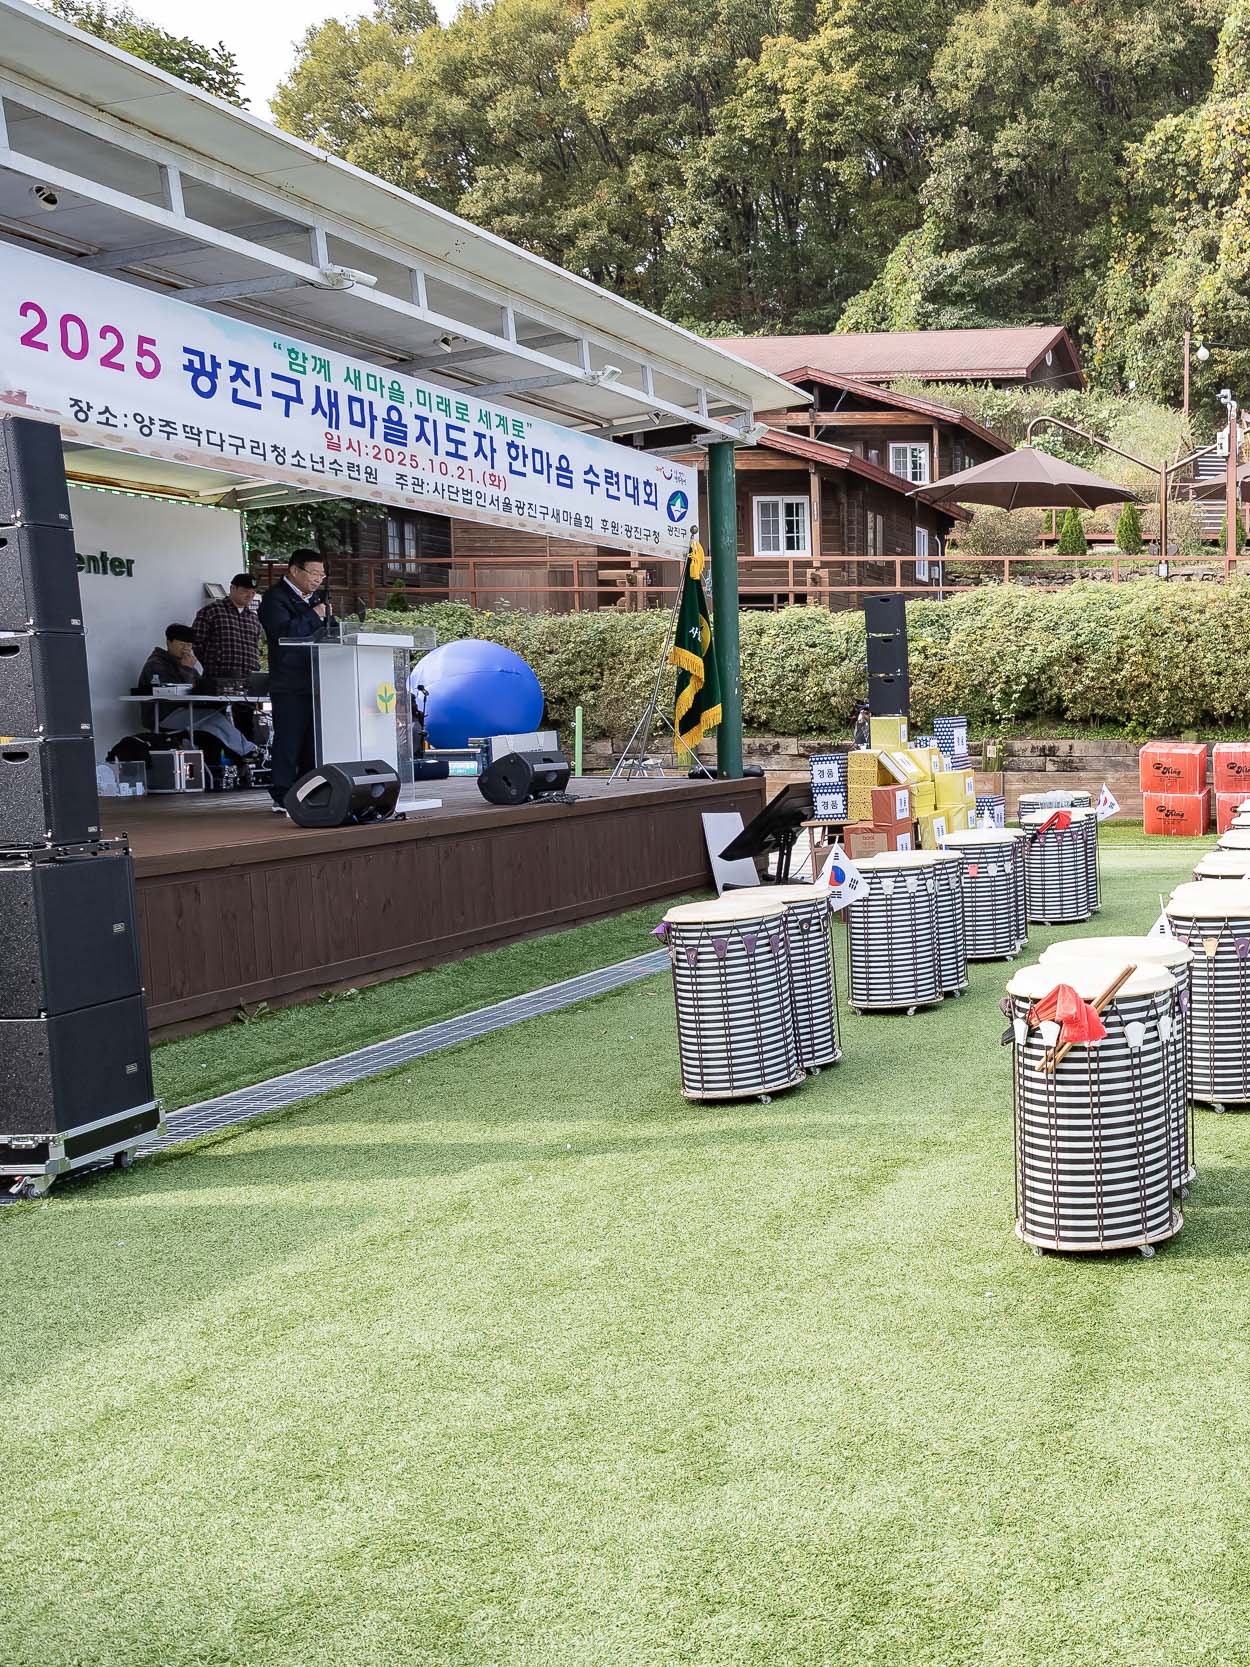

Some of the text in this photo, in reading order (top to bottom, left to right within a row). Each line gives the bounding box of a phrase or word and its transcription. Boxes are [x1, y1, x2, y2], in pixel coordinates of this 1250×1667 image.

[20, 301, 659, 511] 2025 광진구새마을지도자 한마음 수련대회
[344, 366, 470, 424] 새마을,미래로
[69, 397, 661, 544] 장소:양주딱다구리청소년수련원 주관:사단법인서울광진구새마을회 후원:광진구청
[324, 431, 508, 492] 일시:2025.10.21.(화)
[667, 525, 687, 540] 광진구
[73, 551, 134, 577] enter
[817, 769, 834, 779] 경품
[821, 800, 838, 810] 경품
